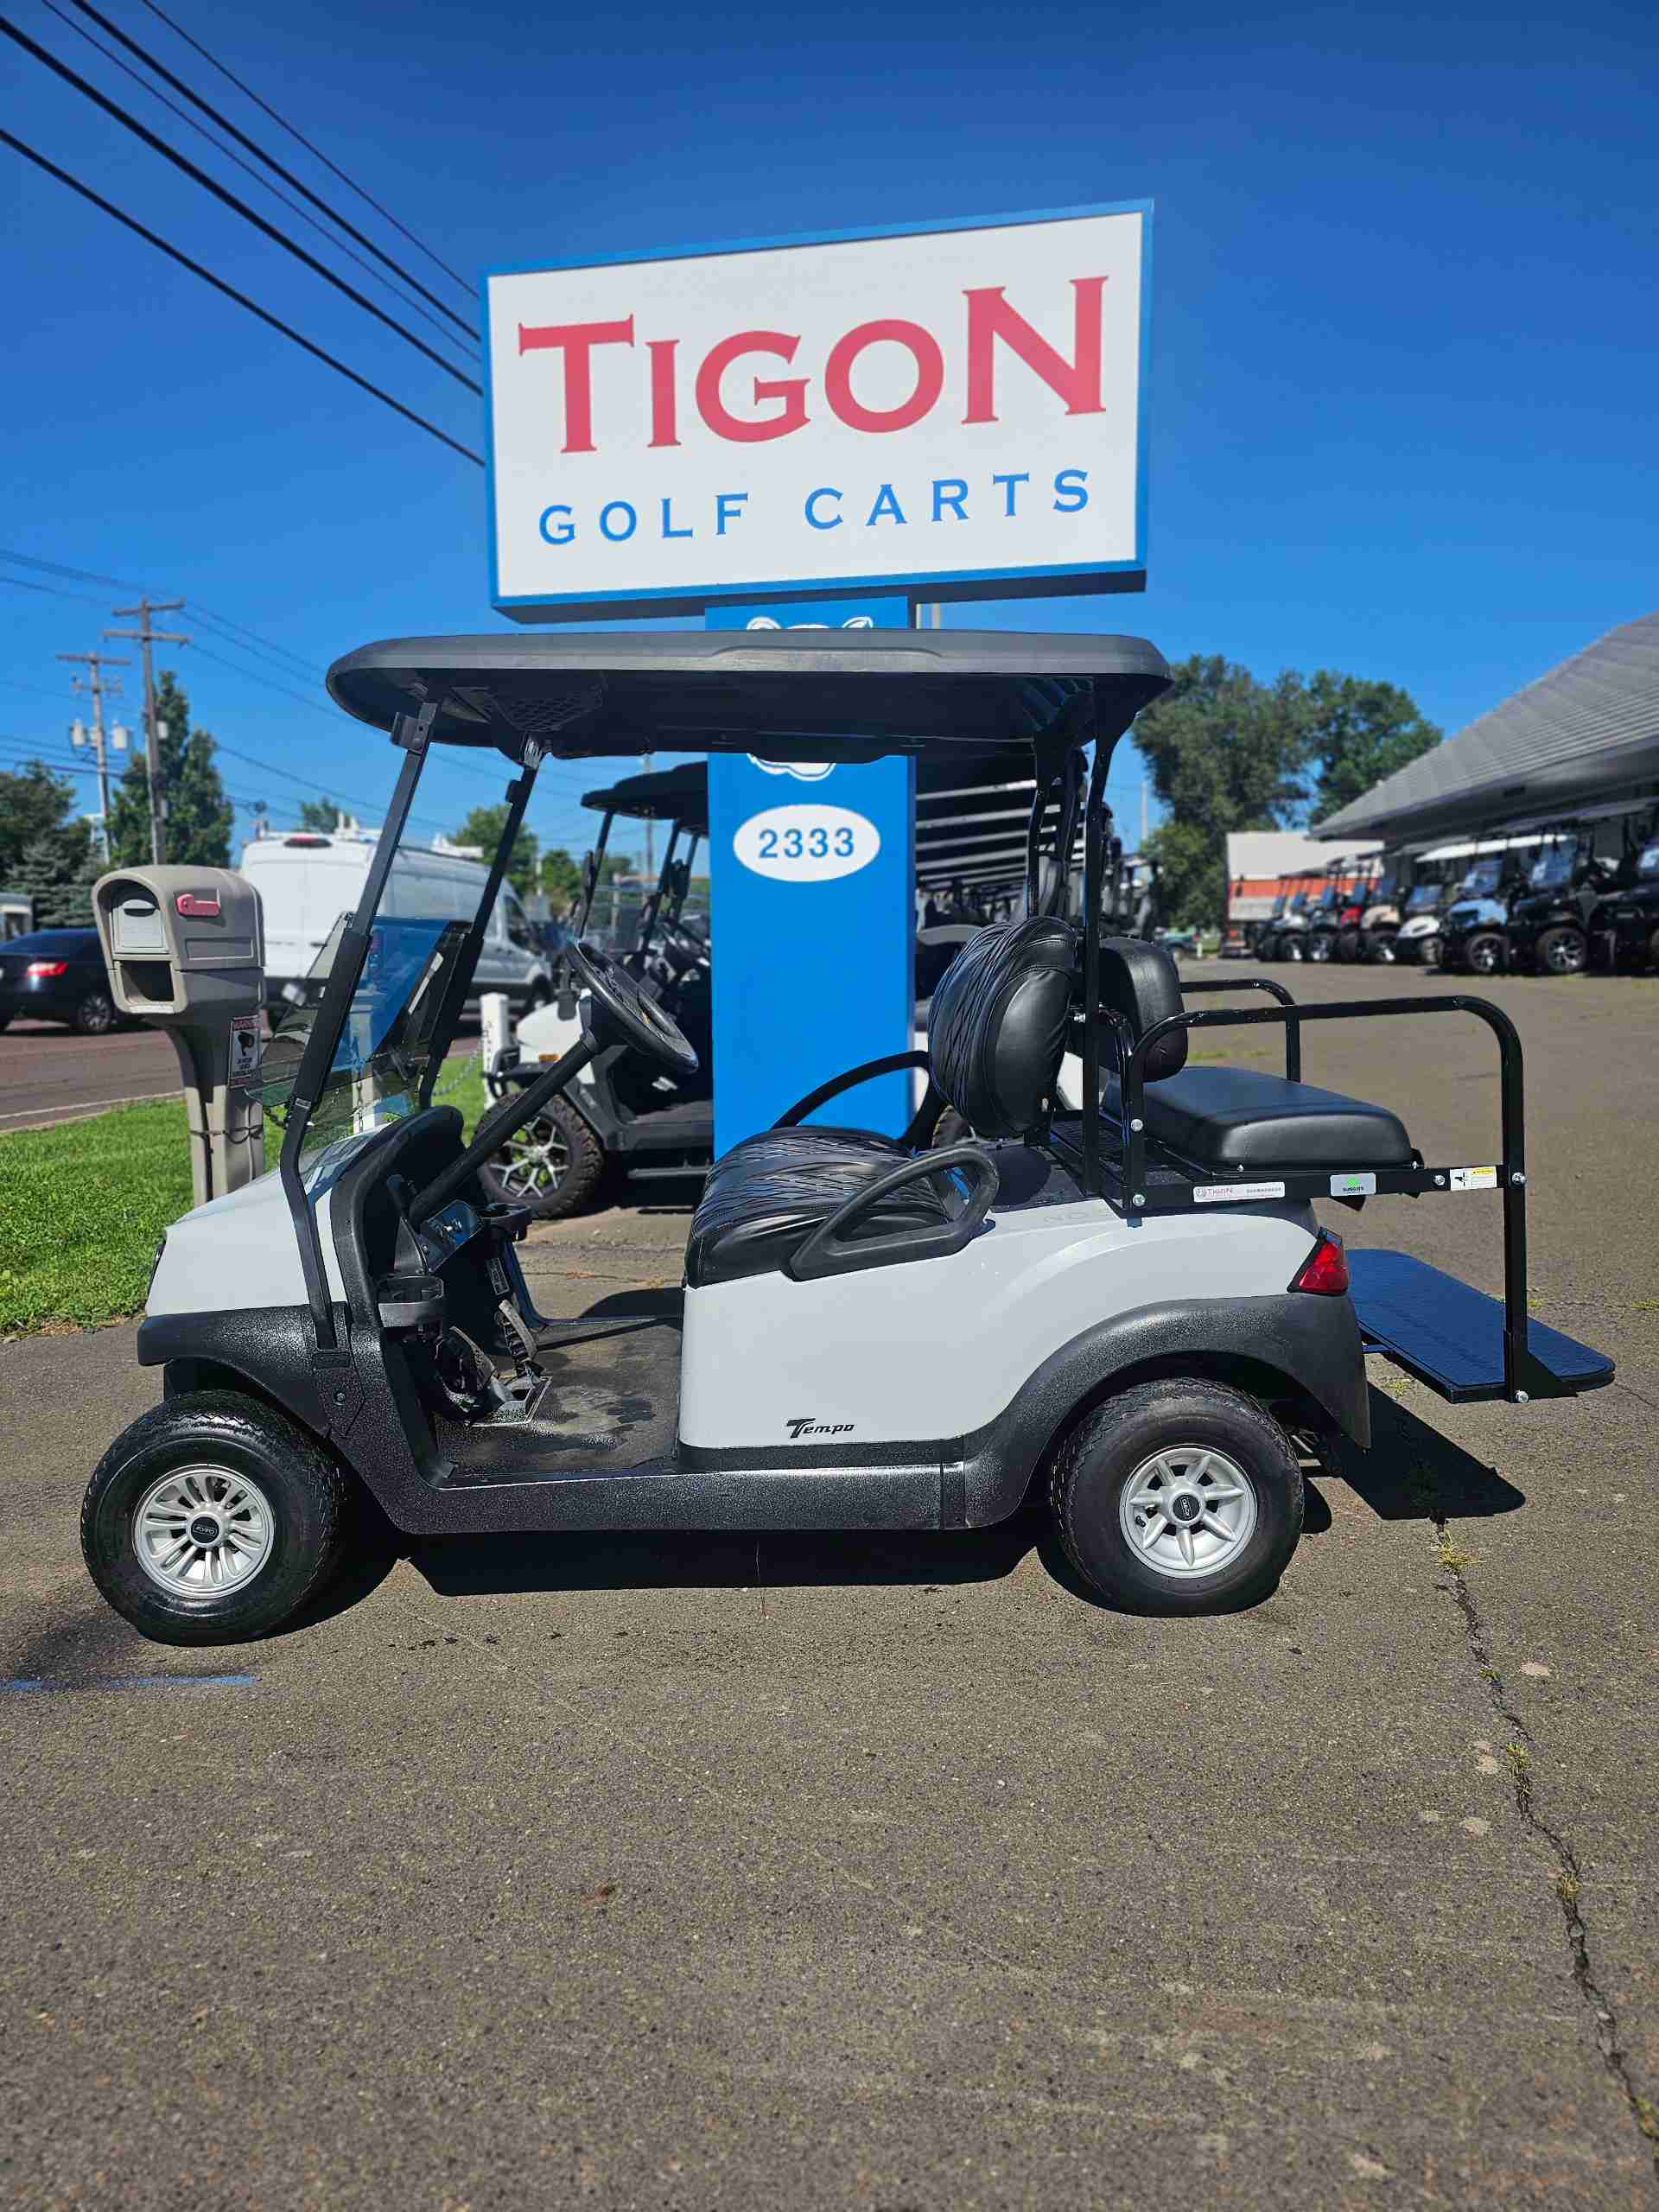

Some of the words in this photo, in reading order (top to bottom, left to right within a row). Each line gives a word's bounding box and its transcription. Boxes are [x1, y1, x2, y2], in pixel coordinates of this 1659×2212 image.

[518, 276, 1108, 454] TIGON
[538, 492, 749, 545] GOLF
[804, 468, 1090, 531] CARTS
[758, 827, 855, 859] 2333
[786, 1417, 855, 1439] Tempo
